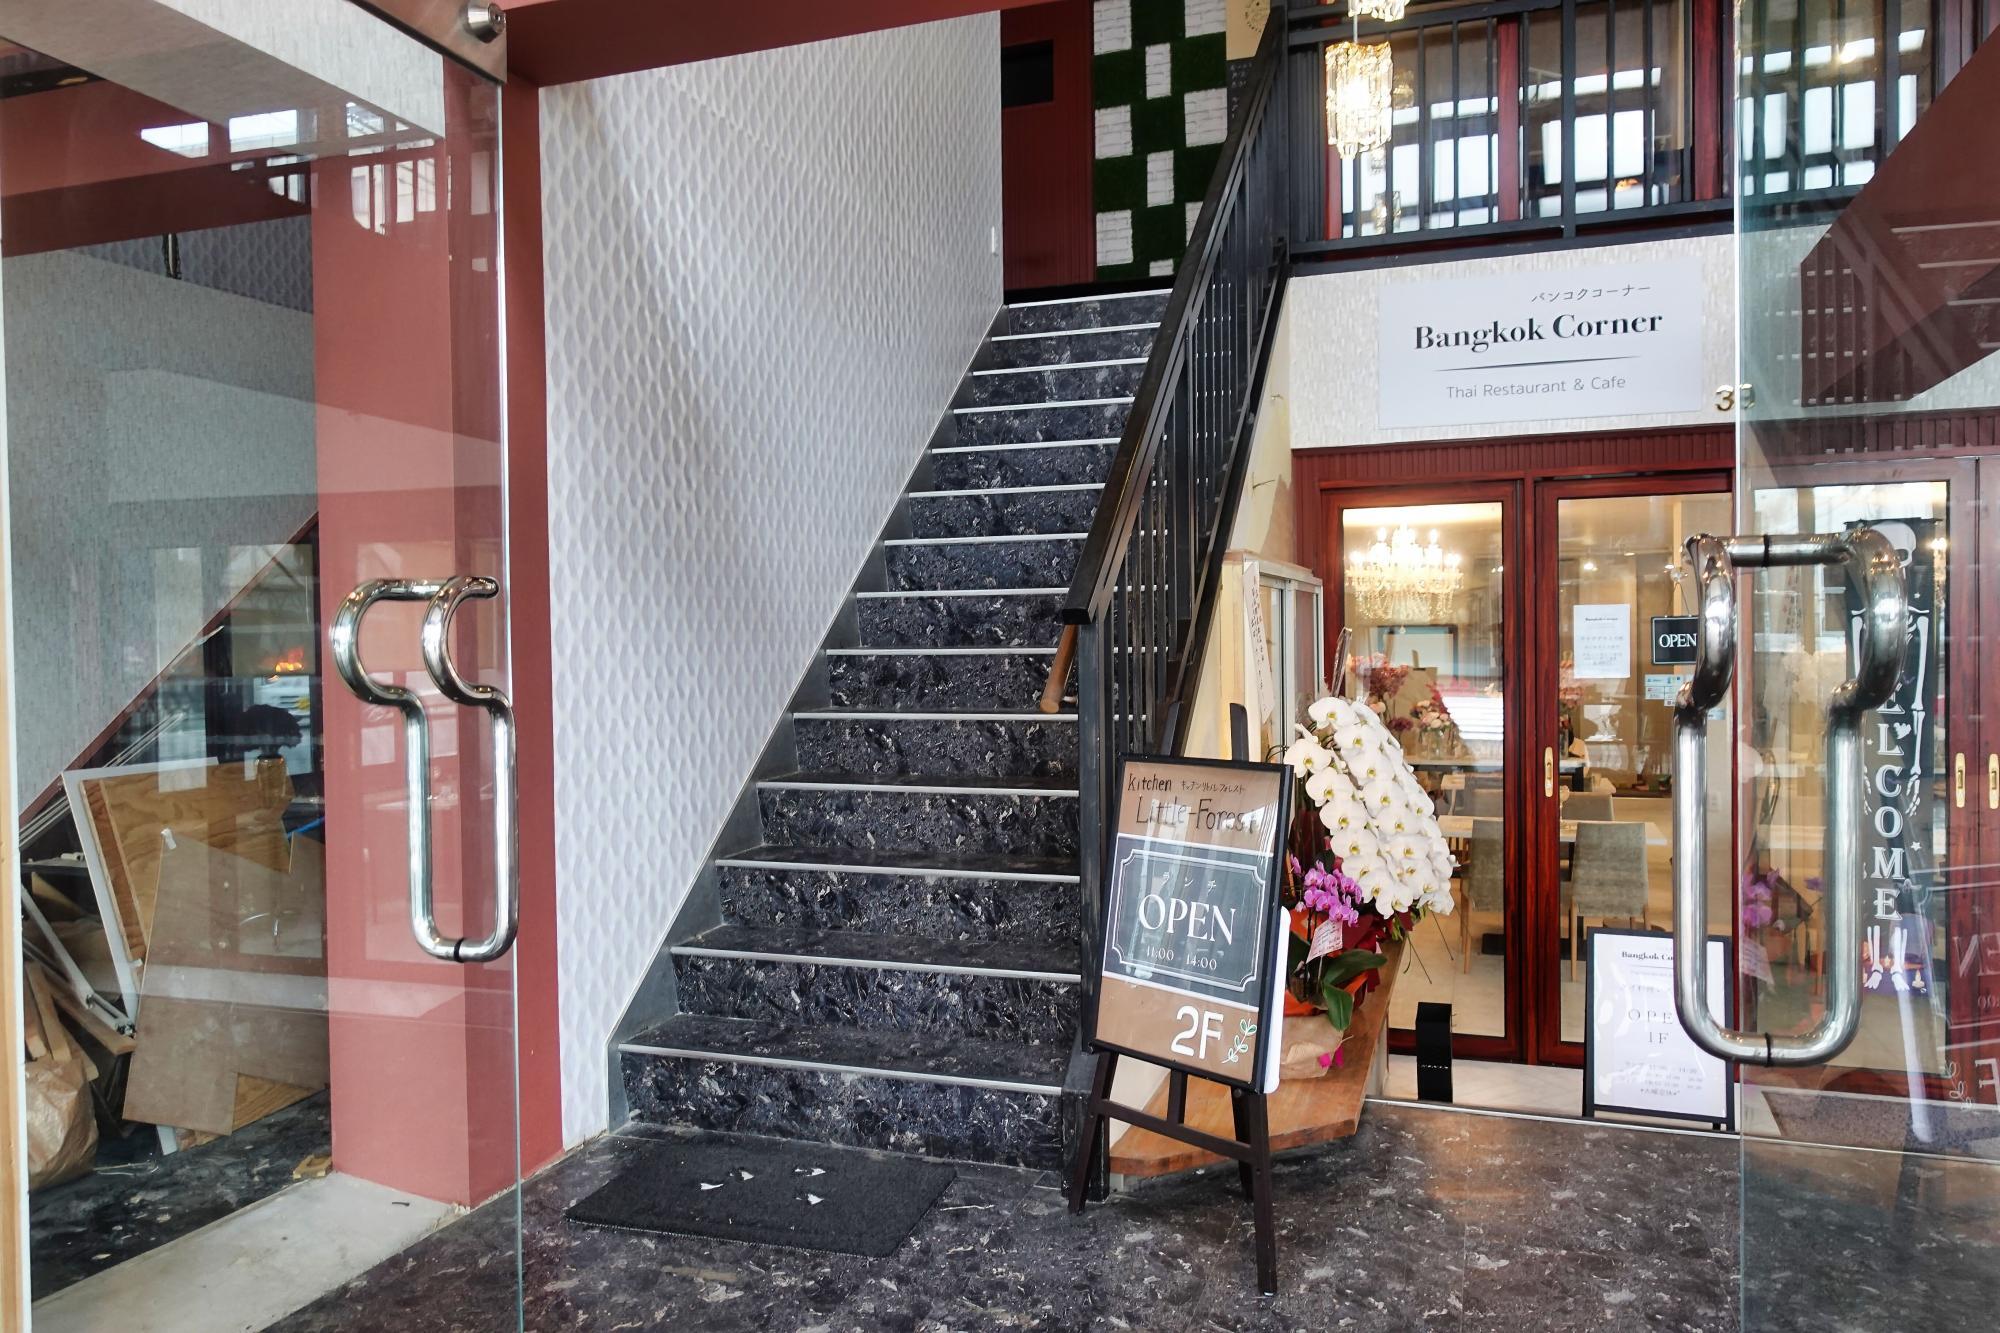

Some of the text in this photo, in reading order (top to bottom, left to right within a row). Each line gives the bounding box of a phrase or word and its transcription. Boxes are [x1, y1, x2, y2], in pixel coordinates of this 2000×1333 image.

[1531, 284, 1651, 302] バンコクコーナー
[1415, 313, 1663, 353] Bangkok Corner
[1447, 375, 1626, 399] Thai Restaurant & Cafe
[1659, 634, 1697, 648] OPEN
[1128, 773, 1172, 791] Kitchen
[1871, 684, 1906, 920] ELCOME
[1139, 894, 1236, 945] OPEN
[1628, 1009, 1673, 1024] OPE
[1171, 1005, 1224, 1059] 2F
